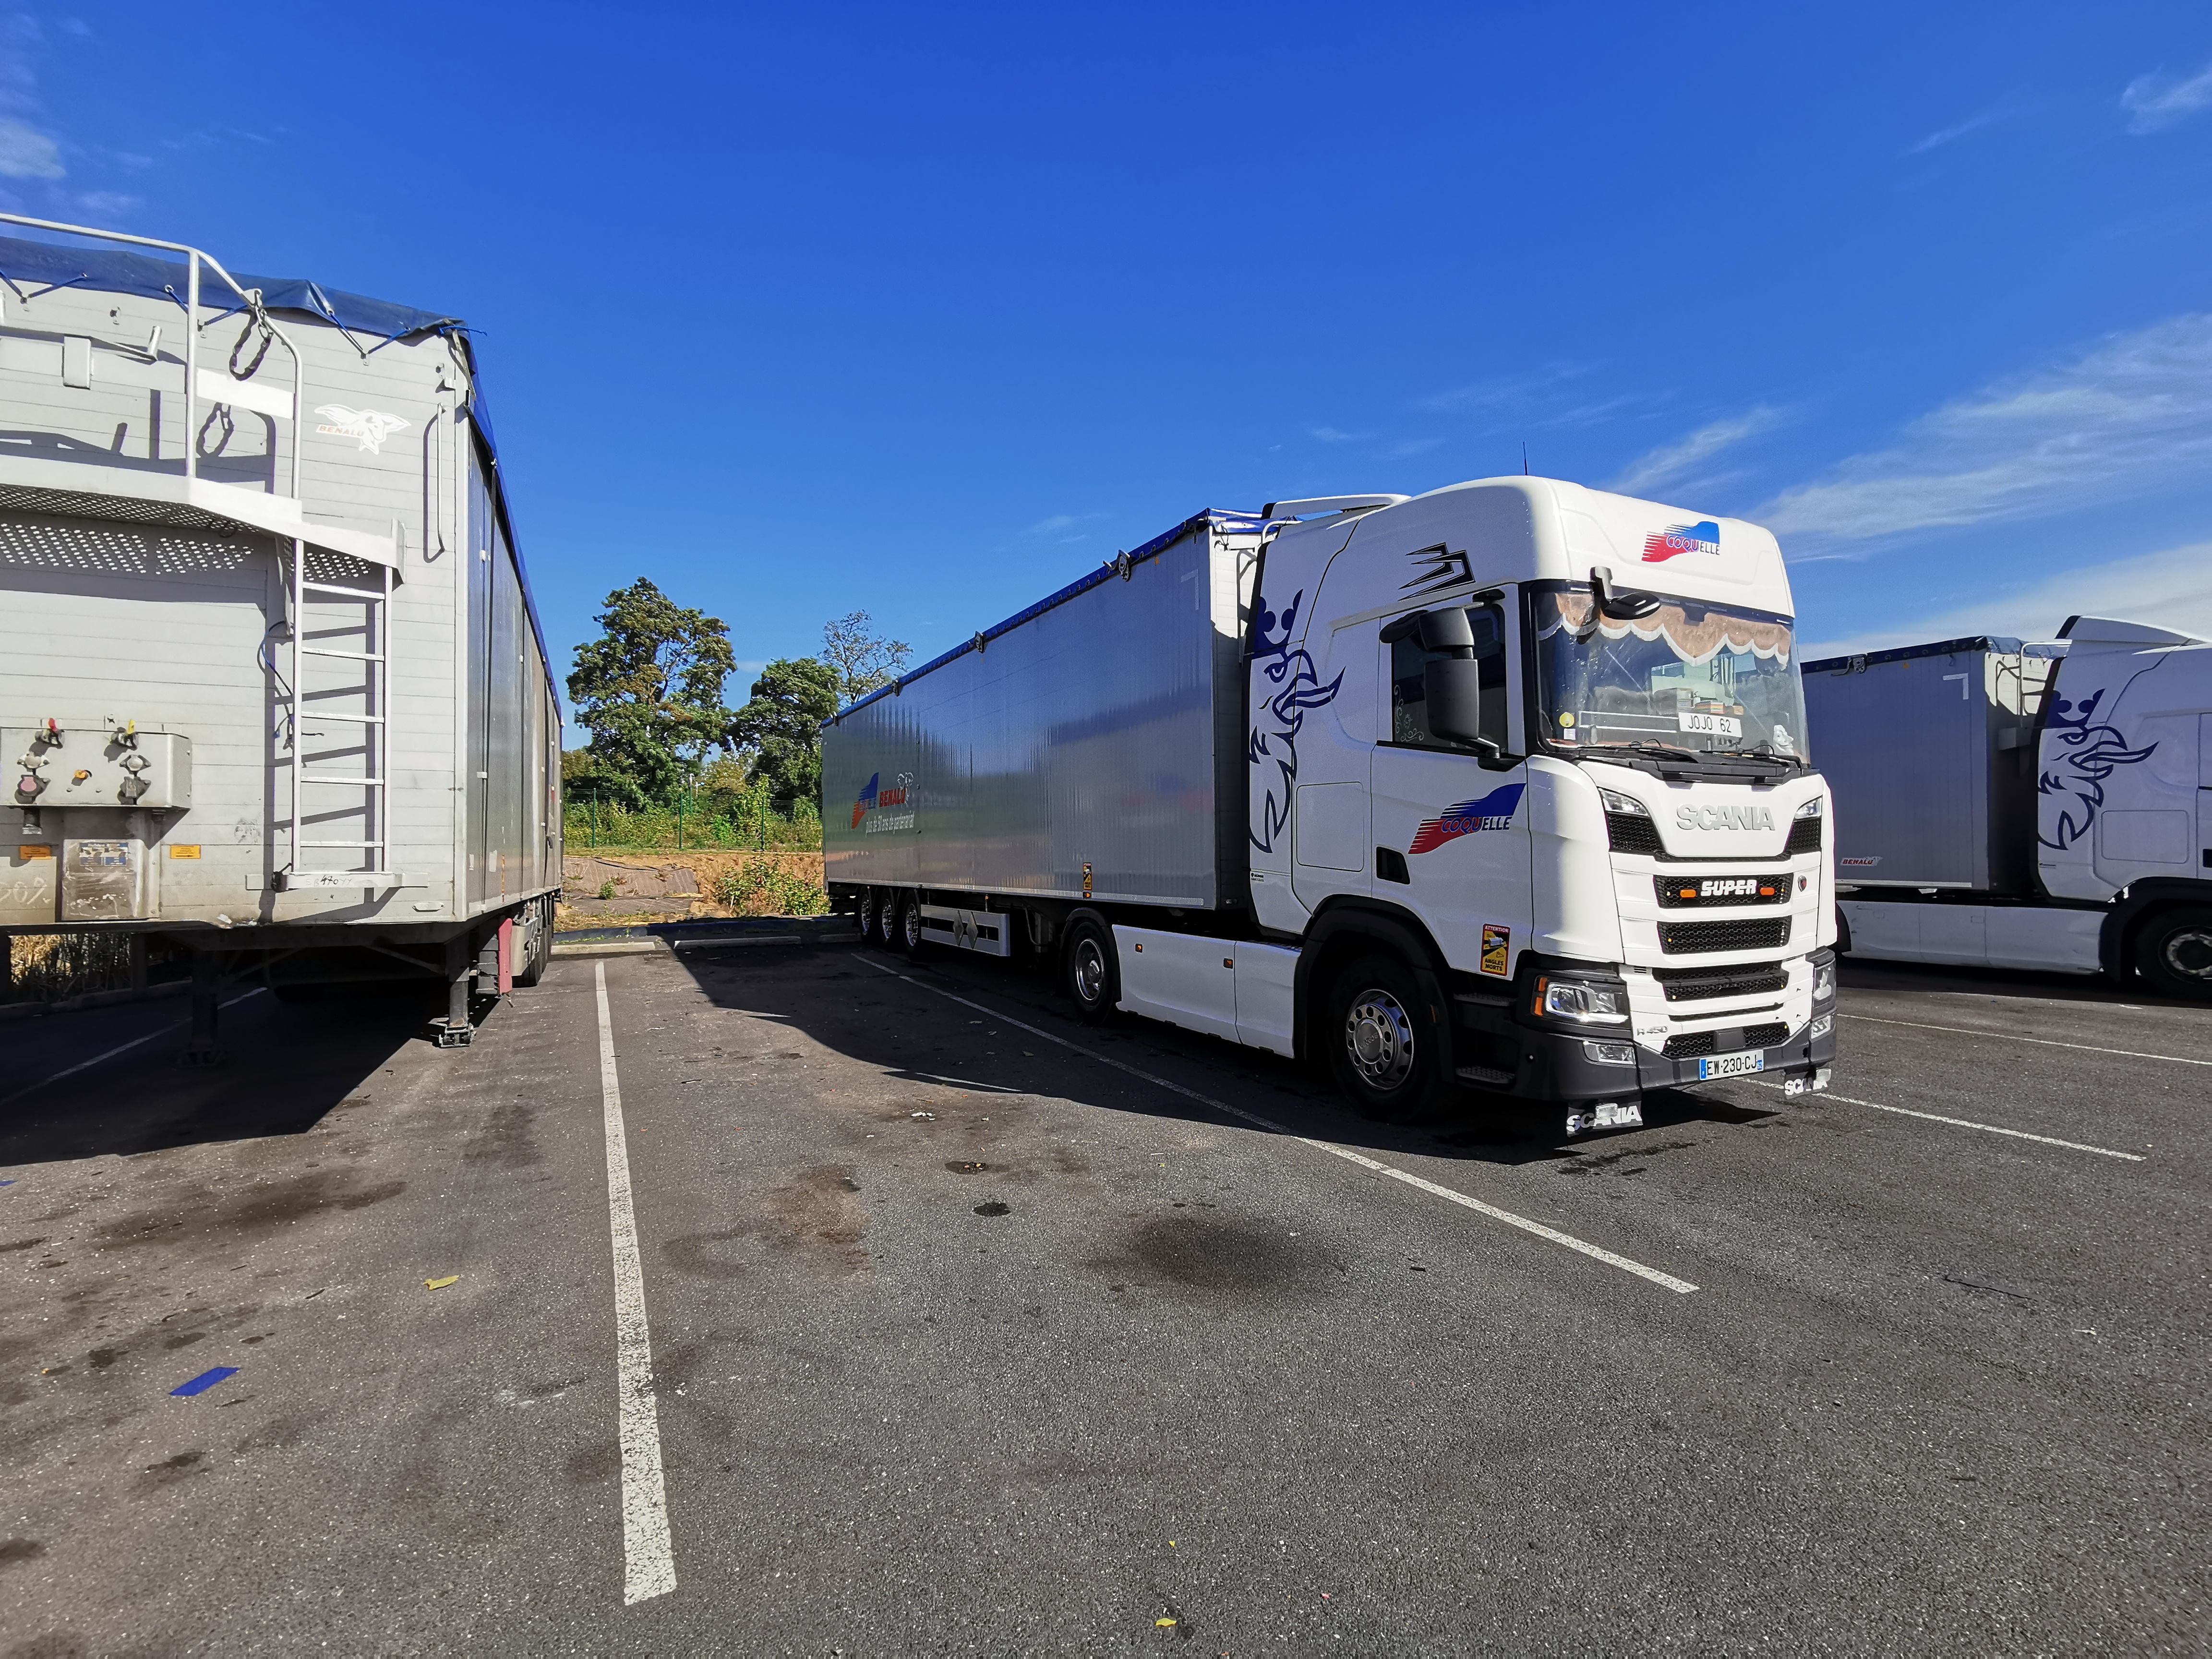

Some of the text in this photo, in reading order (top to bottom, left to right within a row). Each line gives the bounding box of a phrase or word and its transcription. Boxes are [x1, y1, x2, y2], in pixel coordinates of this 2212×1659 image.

[319, 425, 365, 437] BENALU
[1666, 534, 1720, 555] COQUELLE
[1687, 715, 1731, 733] JOJO 62
[1441, 816, 1513, 834] COQUELLE
[1676, 803, 1776, 831] SCANIA
[1700, 879, 1757, 897] SUPER
